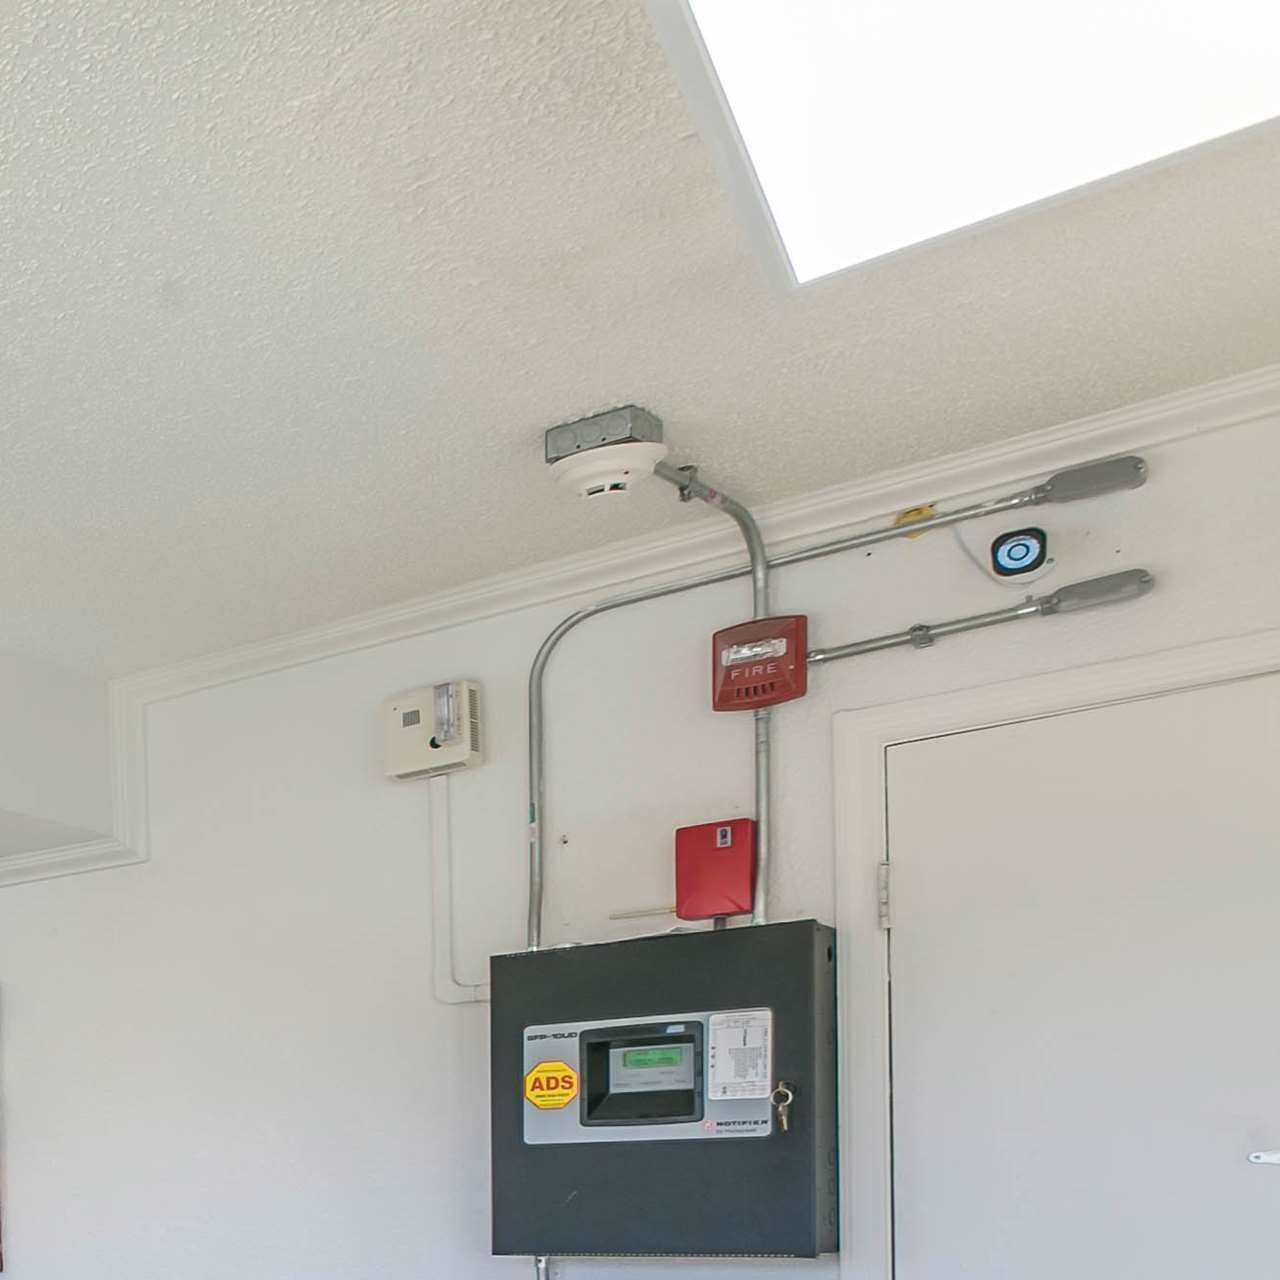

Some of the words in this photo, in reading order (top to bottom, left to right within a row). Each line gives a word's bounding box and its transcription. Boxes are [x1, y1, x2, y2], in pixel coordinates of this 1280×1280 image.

[731, 662, 777, 680] FIRE
[530, 1075, 574, 1091] ADS
[716, 1119, 768, 1127] NOTIFIER
